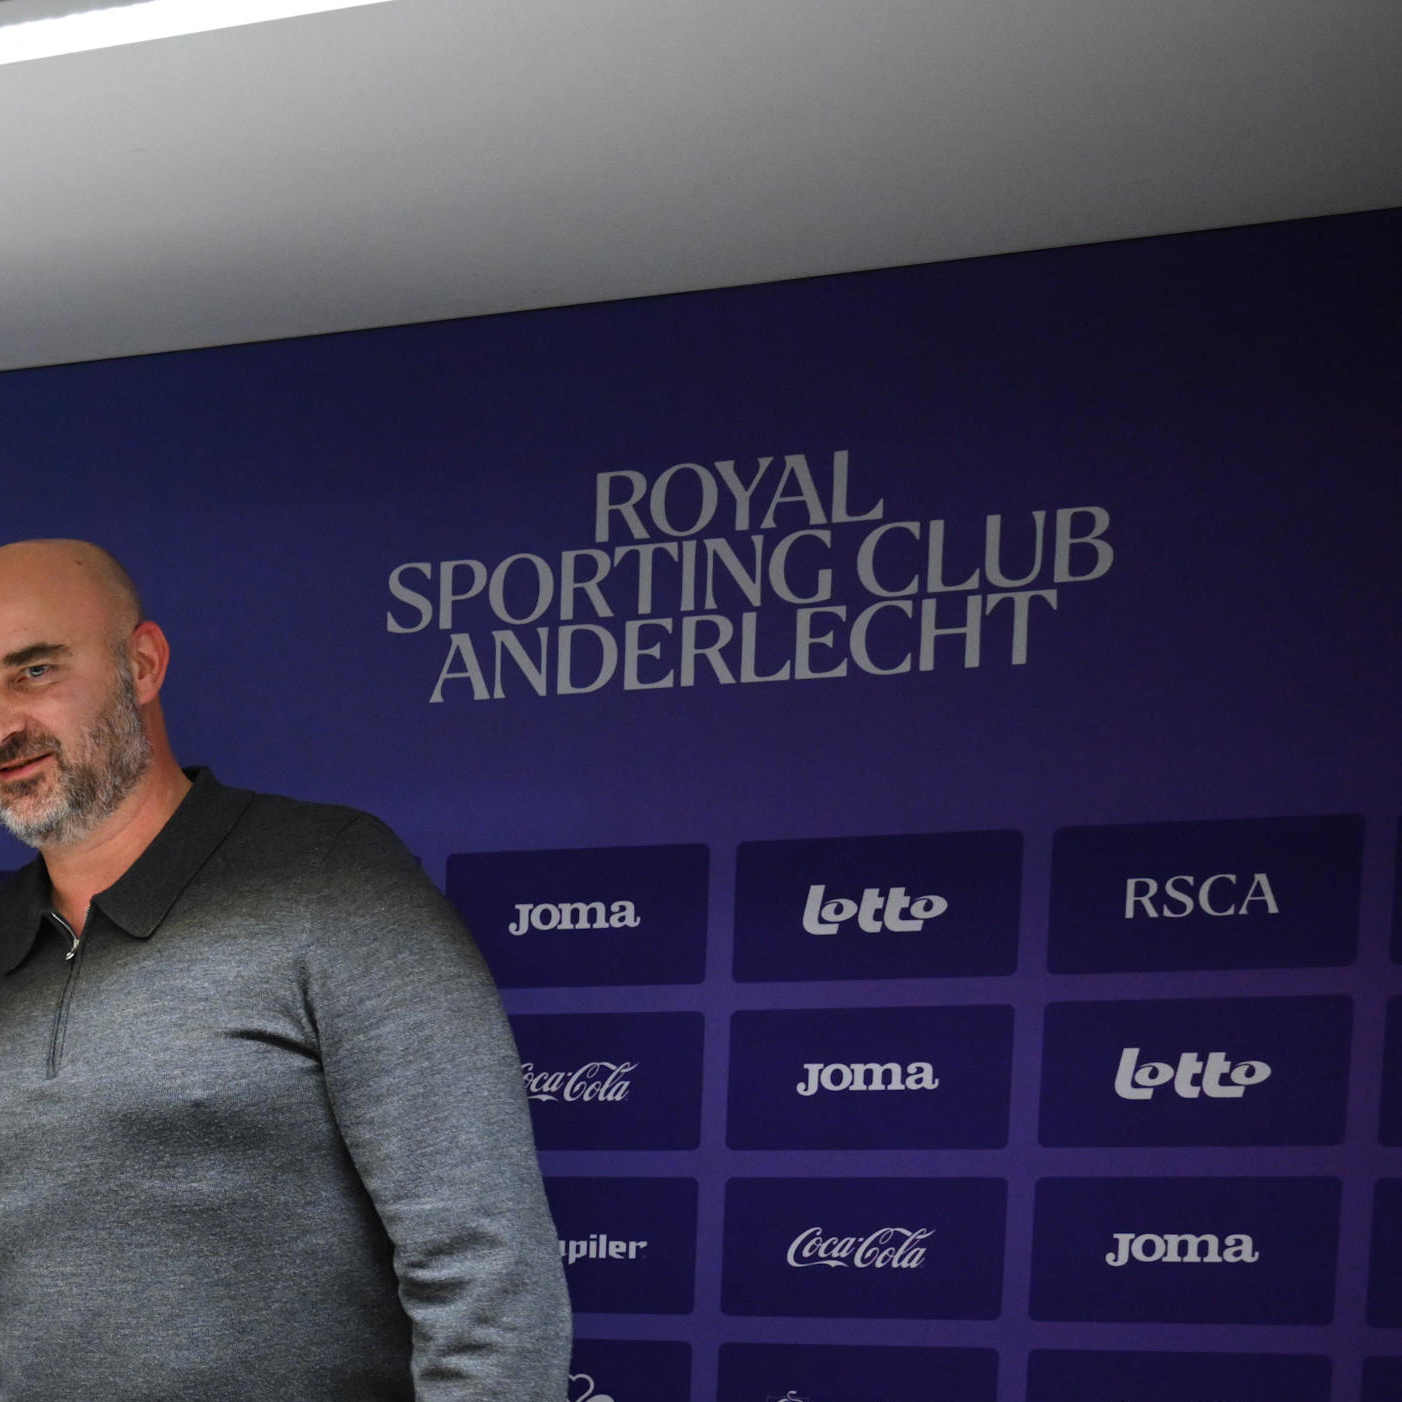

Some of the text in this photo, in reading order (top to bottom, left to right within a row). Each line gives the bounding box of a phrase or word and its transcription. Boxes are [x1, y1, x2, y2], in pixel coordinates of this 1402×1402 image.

[596, 450, 884, 543] ROYAL
[386, 506, 1114, 634] SPORTING CLUB
[429, 589, 1057, 704] ANDERLECHT
[1124, 872, 1280, 919] RSCA
[786, 1226, 936, 1269] Coca-Cola
